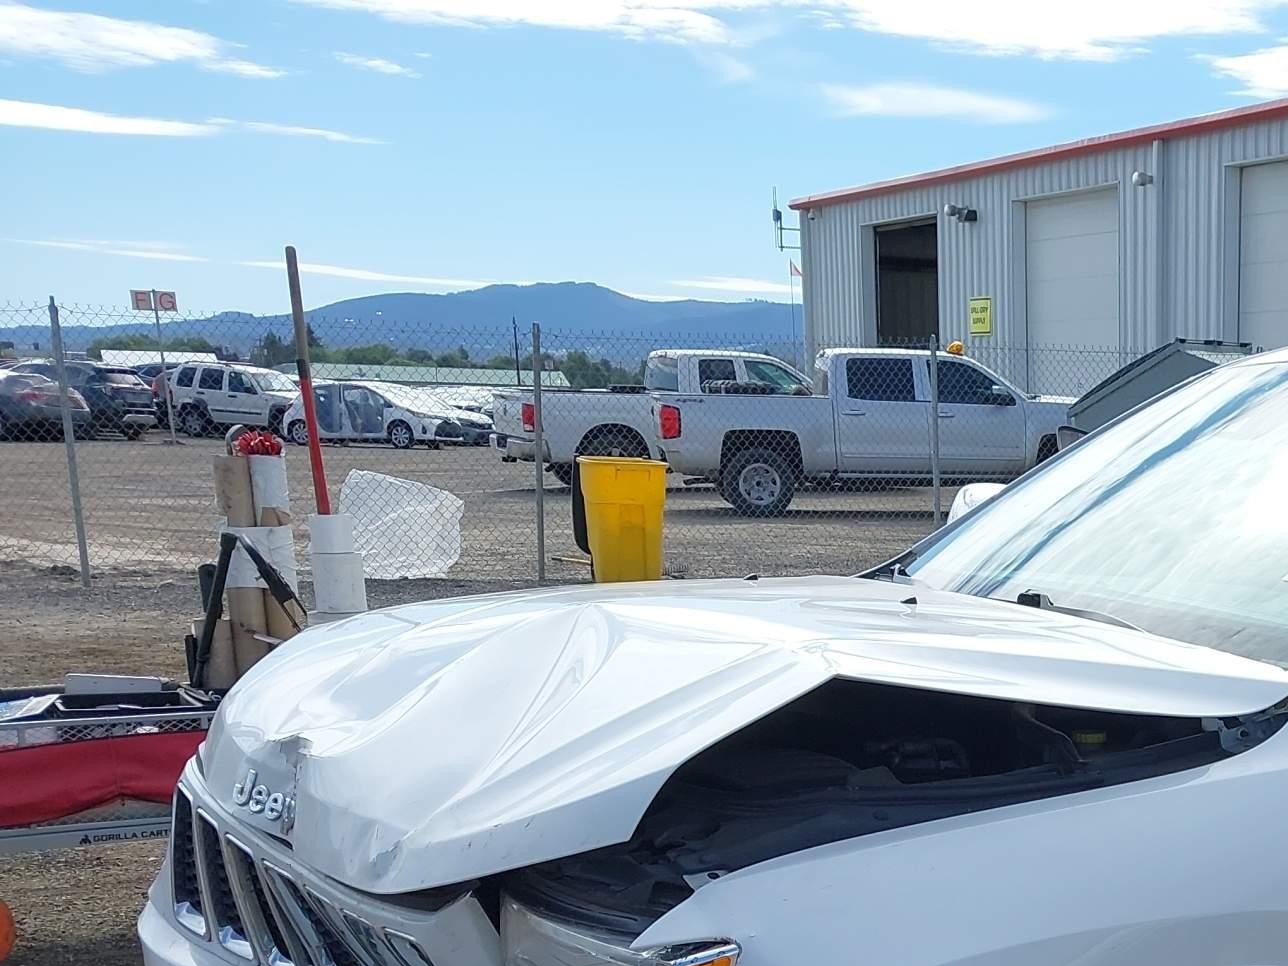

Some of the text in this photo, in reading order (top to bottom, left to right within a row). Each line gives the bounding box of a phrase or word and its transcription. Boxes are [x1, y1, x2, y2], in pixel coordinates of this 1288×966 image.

[159, 292, 176, 310] G
[233, 769, 296, 835] Jeep
[93, 832, 138, 842] GORILLA
